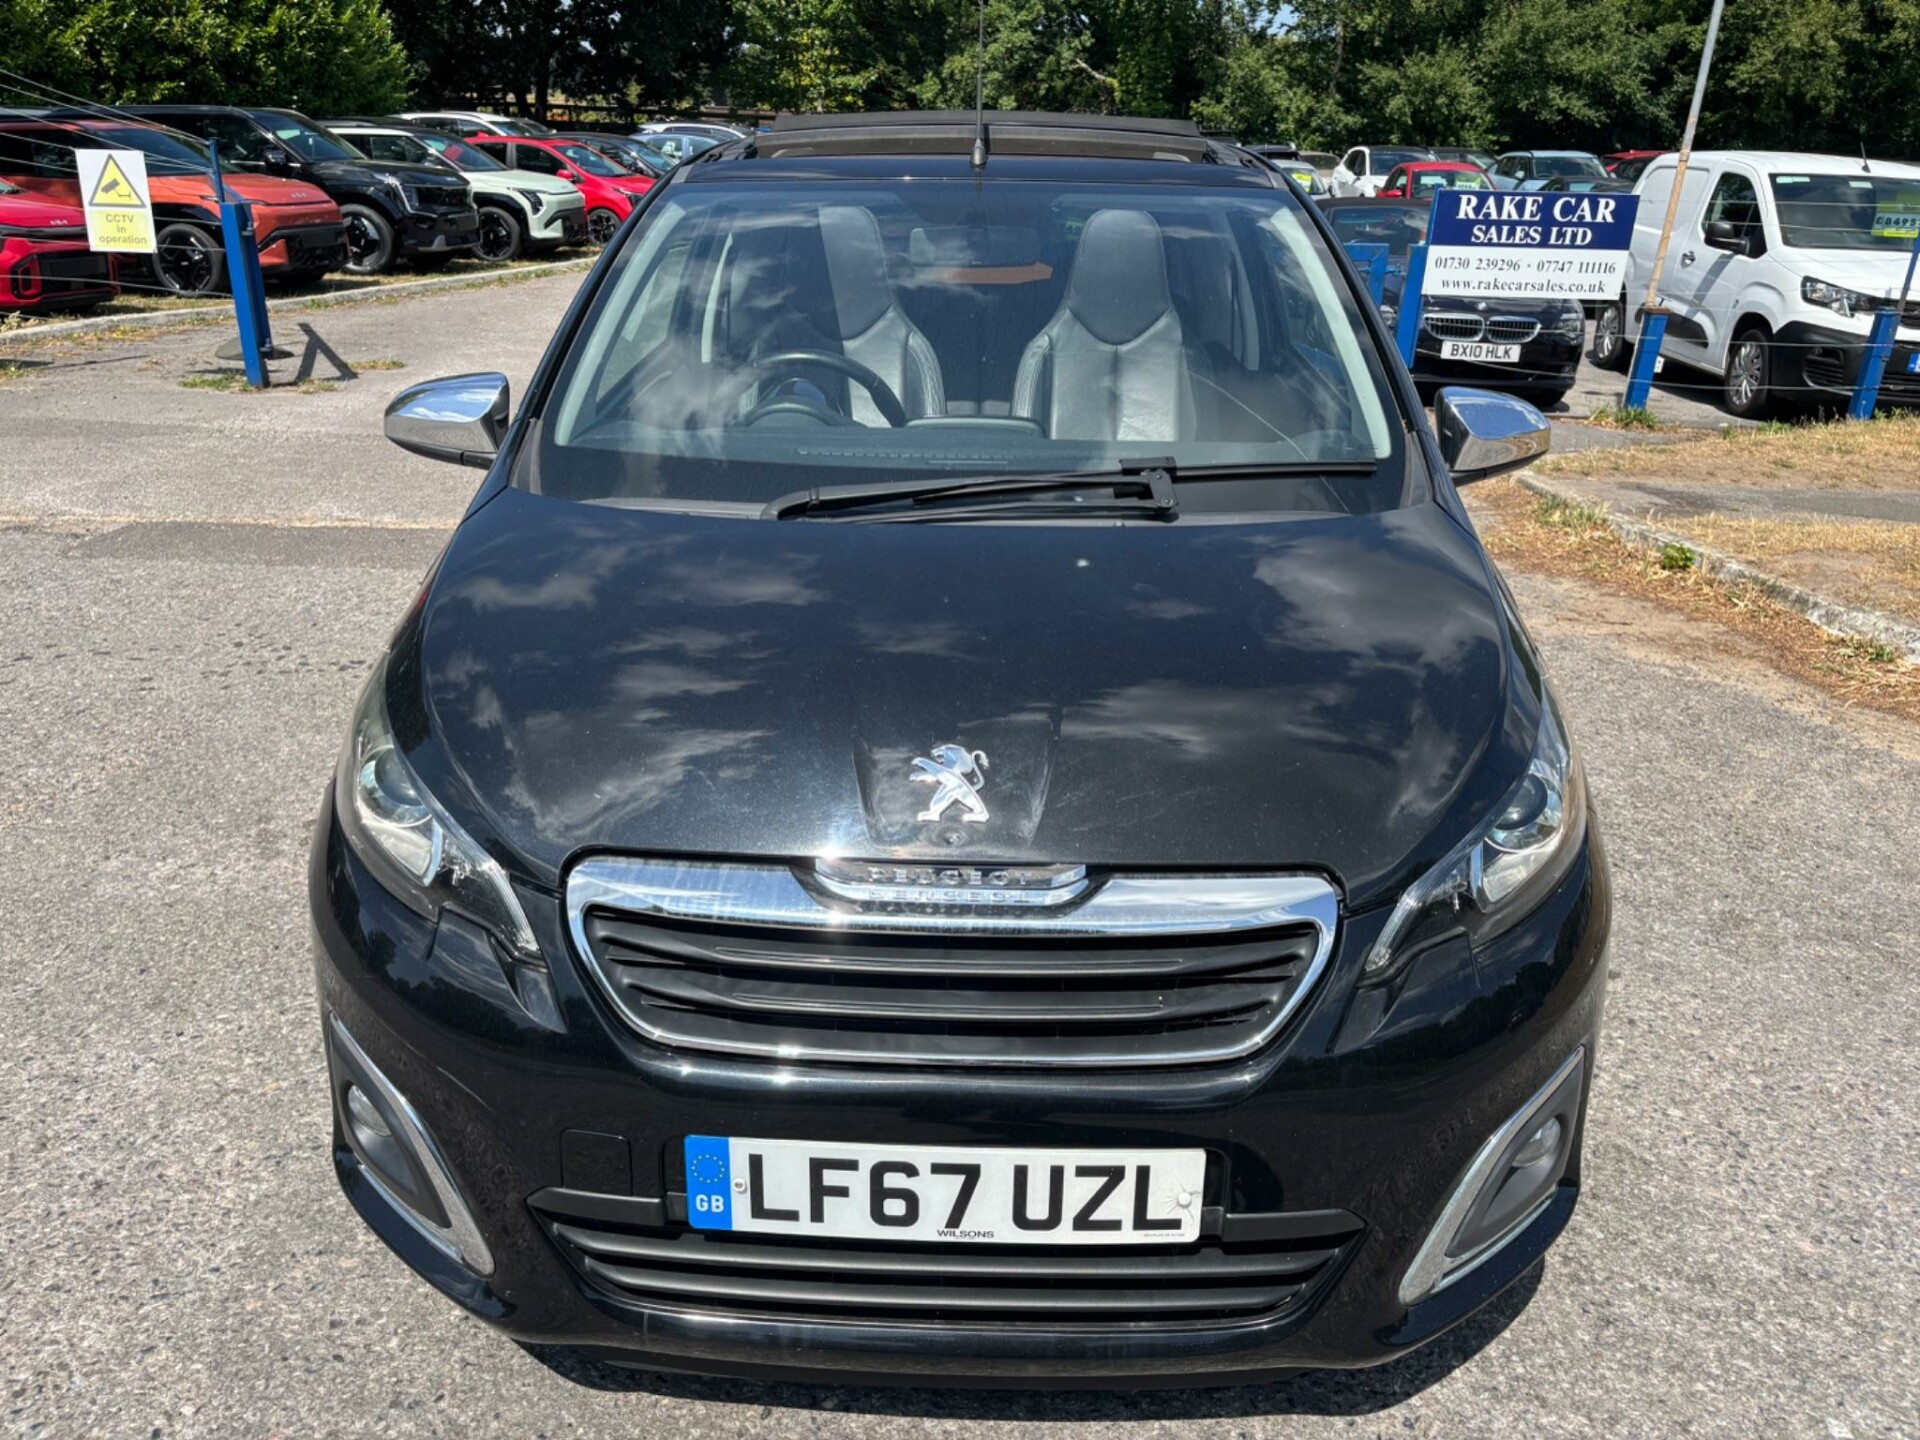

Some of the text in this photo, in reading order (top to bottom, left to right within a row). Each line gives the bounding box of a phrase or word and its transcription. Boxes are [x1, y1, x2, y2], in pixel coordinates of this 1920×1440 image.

[1456, 194, 1616, 223] RAKE CAR
[106, 213, 134, 223] CCTV
[117, 225, 126, 233] in
[1471, 225, 1593, 245] SALES LTD
[99, 234, 147, 245] operation
[1435, 257, 1470, 270] 01730
[1475, 258, 1521, 271] 239296
[1537, 260, 1574, 273] 07747
[1441, 277, 1606, 294] www.rakecarsales.co.uk
[1450, 343, 1512, 360] BX10 HLK
[748, 1153, 1182, 1231] LF67 UZL
[695, 1194, 724, 1213] GB
[936, 1229, 995, 1239] WILSONS
